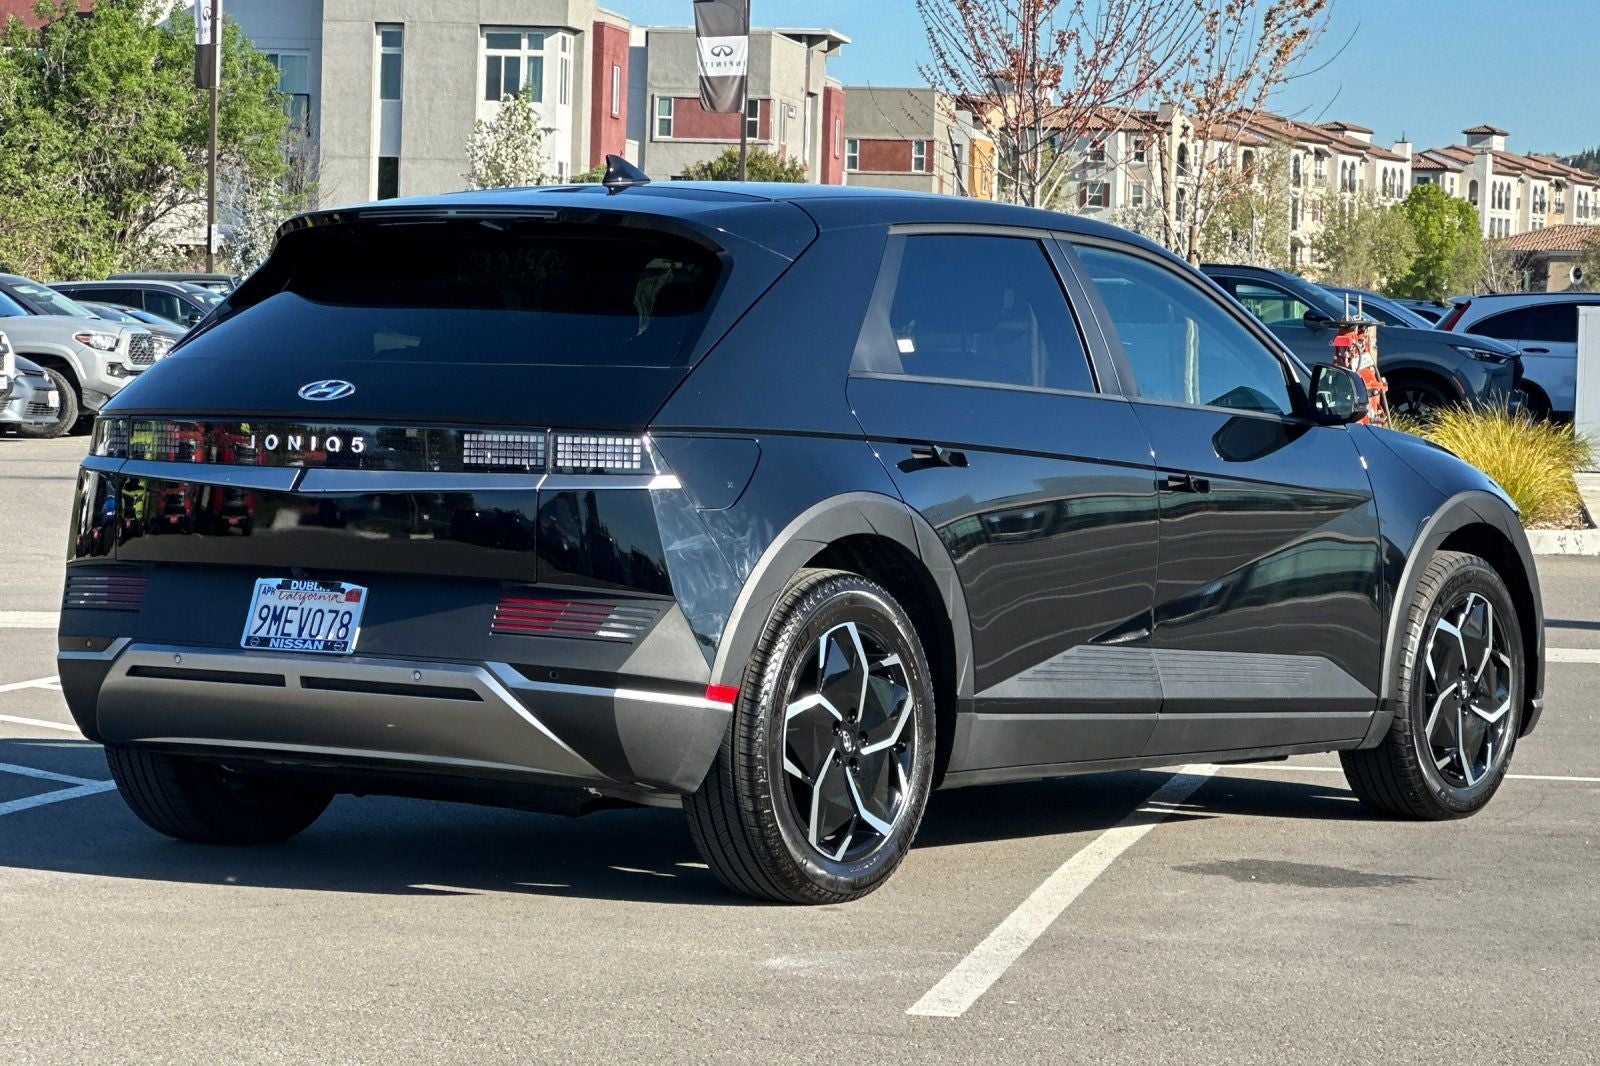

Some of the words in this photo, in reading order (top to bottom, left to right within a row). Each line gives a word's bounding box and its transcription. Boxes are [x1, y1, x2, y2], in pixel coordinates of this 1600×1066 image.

[291, 580, 331, 593] DUBL
[279, 590, 344, 606] California
[253, 604, 353, 640] 9MEV078
[269, 638, 324, 650] NISSAN
